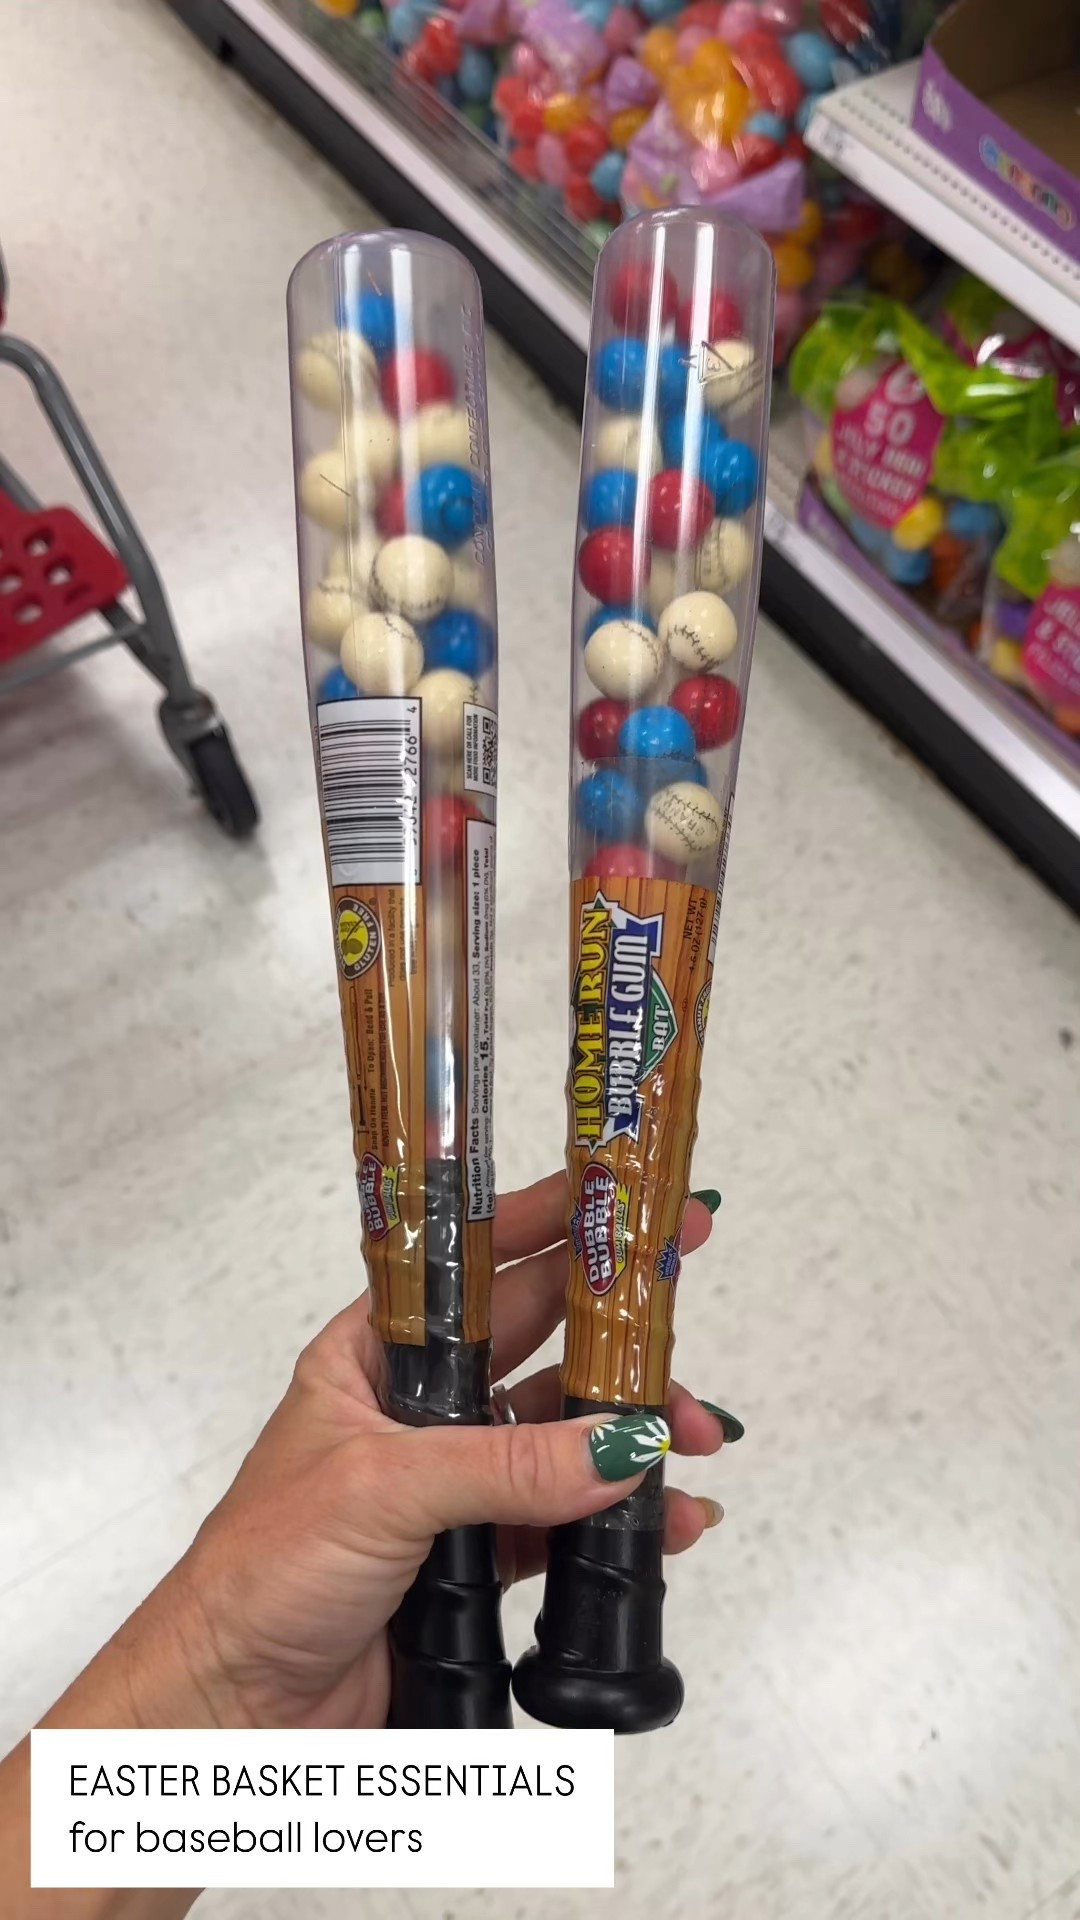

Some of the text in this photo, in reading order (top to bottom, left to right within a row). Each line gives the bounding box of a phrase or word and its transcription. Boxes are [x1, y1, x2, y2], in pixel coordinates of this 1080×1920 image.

[352, 903, 377, 971] GLUTEN FREE
[473, 919, 481, 958] Serving
[683, 899, 698, 939] NET WT
[695, 911, 704, 936] (127
[691, 937, 701, 953] OZ
[472, 963, 481, 976] 33,
[365, 989, 373, 1005] Pull
[472, 978, 480, 1006] About
[472, 1008, 480, 1054] container:
[573, 909, 611, 1140] HOME RUN
[607, 934, 648, 1116] BUBBLE GUM
[652, 1004, 669, 1053] BAT
[367, 1064, 375, 1072] To
[472, 1056, 480, 1071] per
[480, 1037, 489, 1060] 15,
[471, 1074, 480, 1114] Servings
[481, 1065, 489, 1113] Calories
[469, 1118, 479, 1153] Facts
[366, 1161, 384, 1230] BUBBLE
[469, 1158, 483, 1215] Nutrition
[584, 1180, 599, 1283] DUBBLE
[595, 1176, 612, 1279] BUBBLE
[615, 1200, 625, 1263] GUM BALLS
